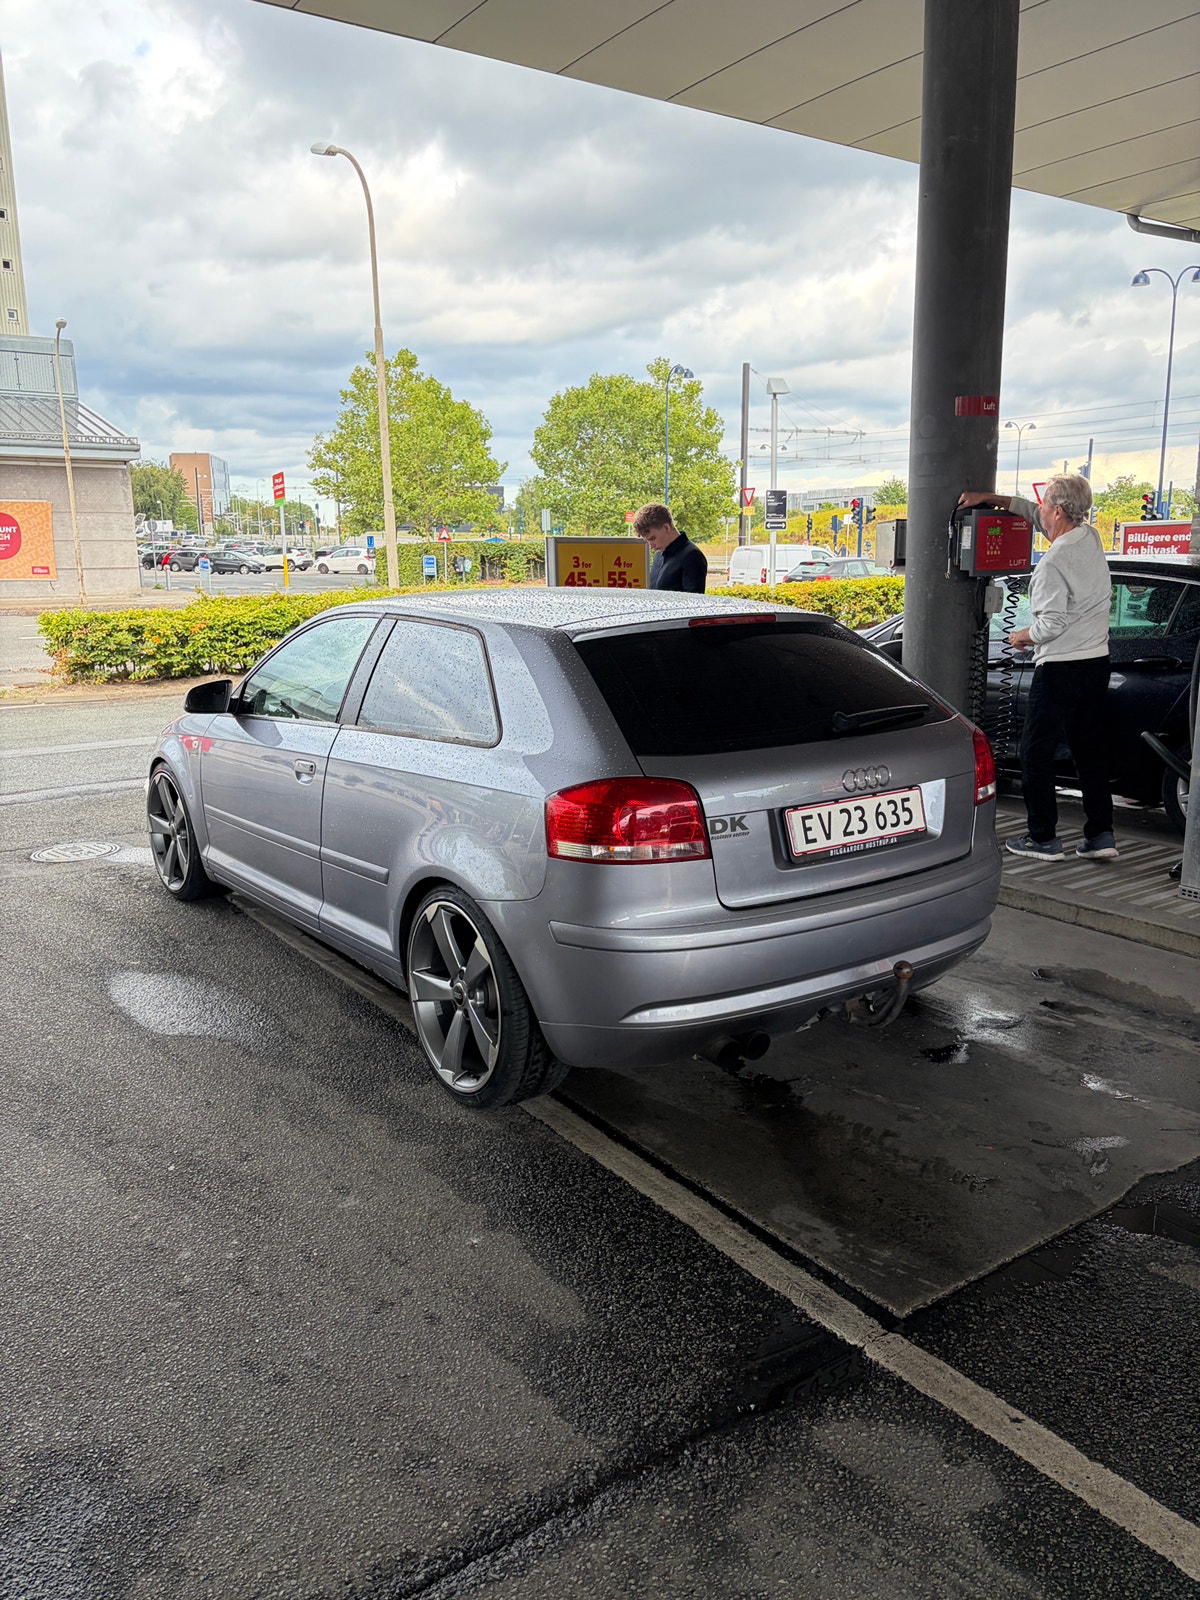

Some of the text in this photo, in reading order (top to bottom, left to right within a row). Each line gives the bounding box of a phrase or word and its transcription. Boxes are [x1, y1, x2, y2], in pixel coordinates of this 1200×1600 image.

[983, 401, 996, 410] Luft
[1127, 532, 1192, 544] Billigere end
[1127, 545, 1139, 554] én
[572, 556, 592, 569] 3 for
[613, 556, 633, 569] 4 for
[1009, 559, 1027, 567] LUFT
[709, 815, 749, 835] DK
[801, 797, 914, 845] EV 23 635
